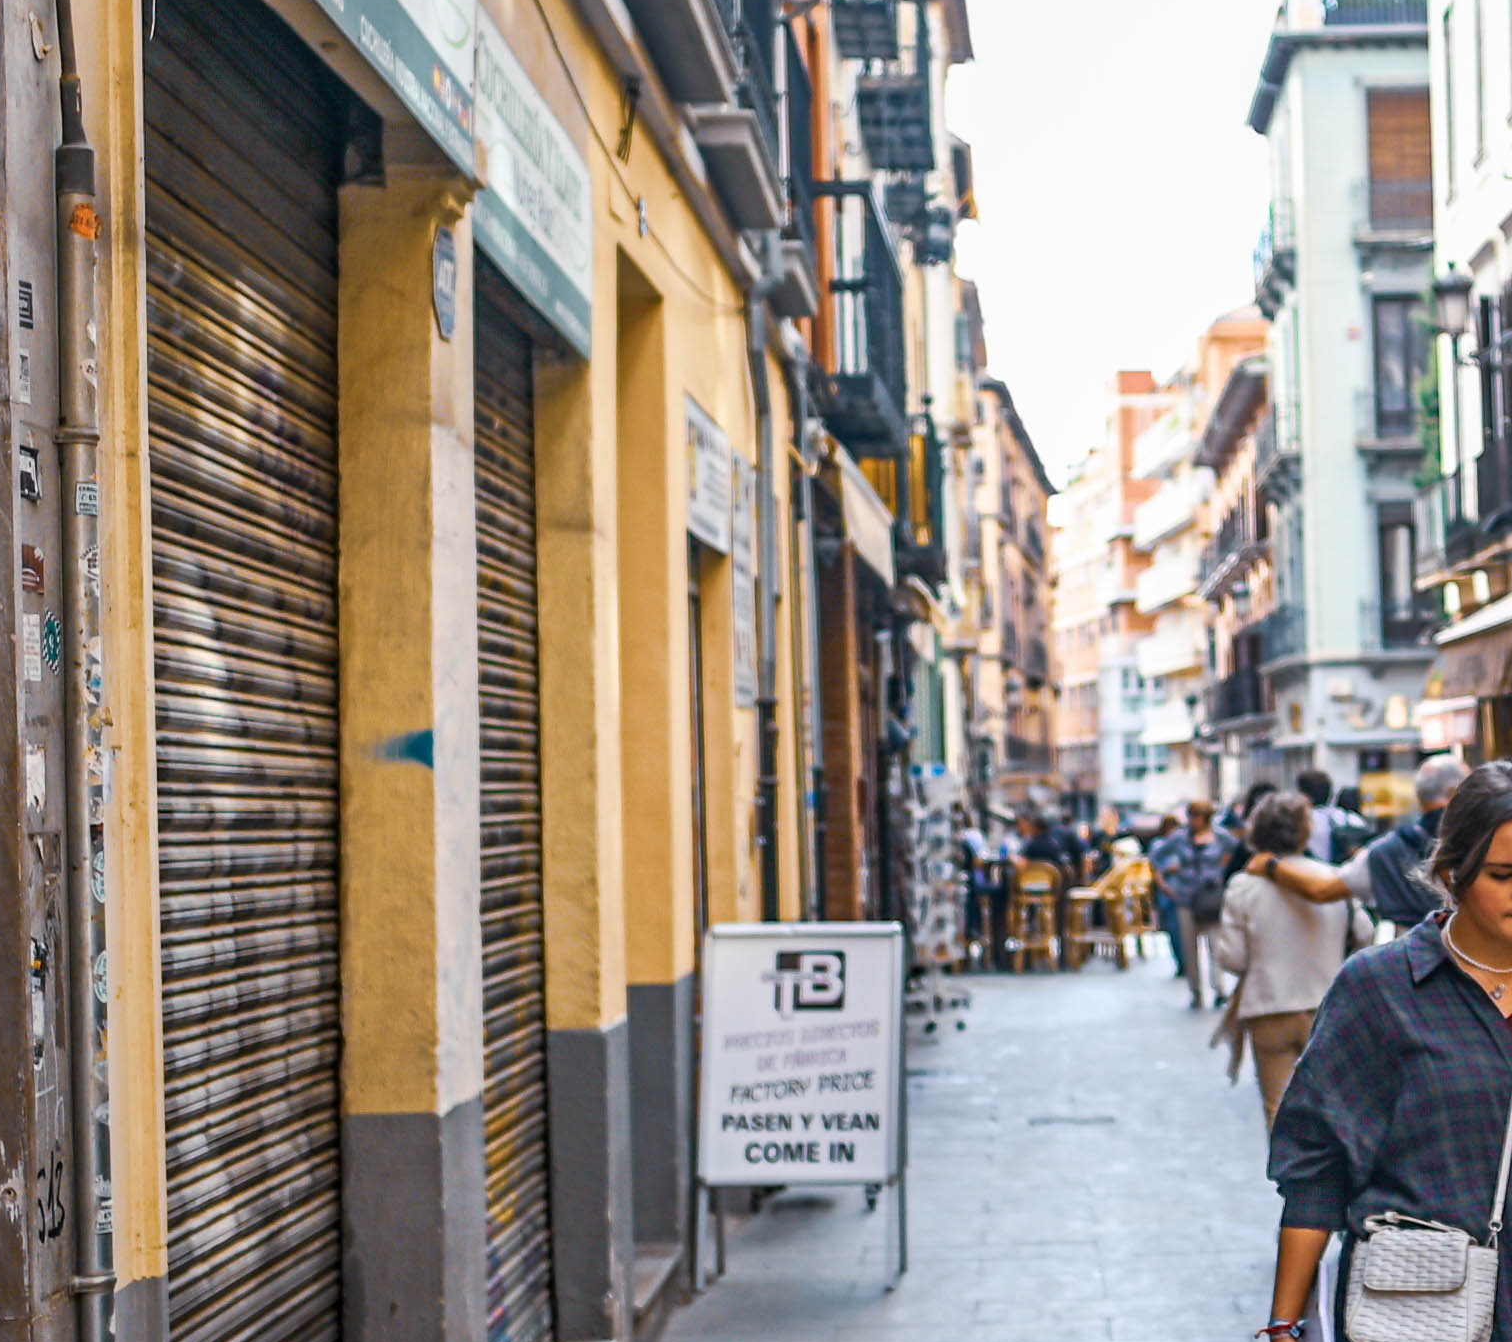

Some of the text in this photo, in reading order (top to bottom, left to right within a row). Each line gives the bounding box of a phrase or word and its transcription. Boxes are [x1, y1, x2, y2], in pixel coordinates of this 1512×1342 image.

[730, 1069, 877, 1105] FACTORY PRICE
[721, 1113, 881, 1132] PASEN Y VEAN
[744, 1142, 856, 1164] COME IN
